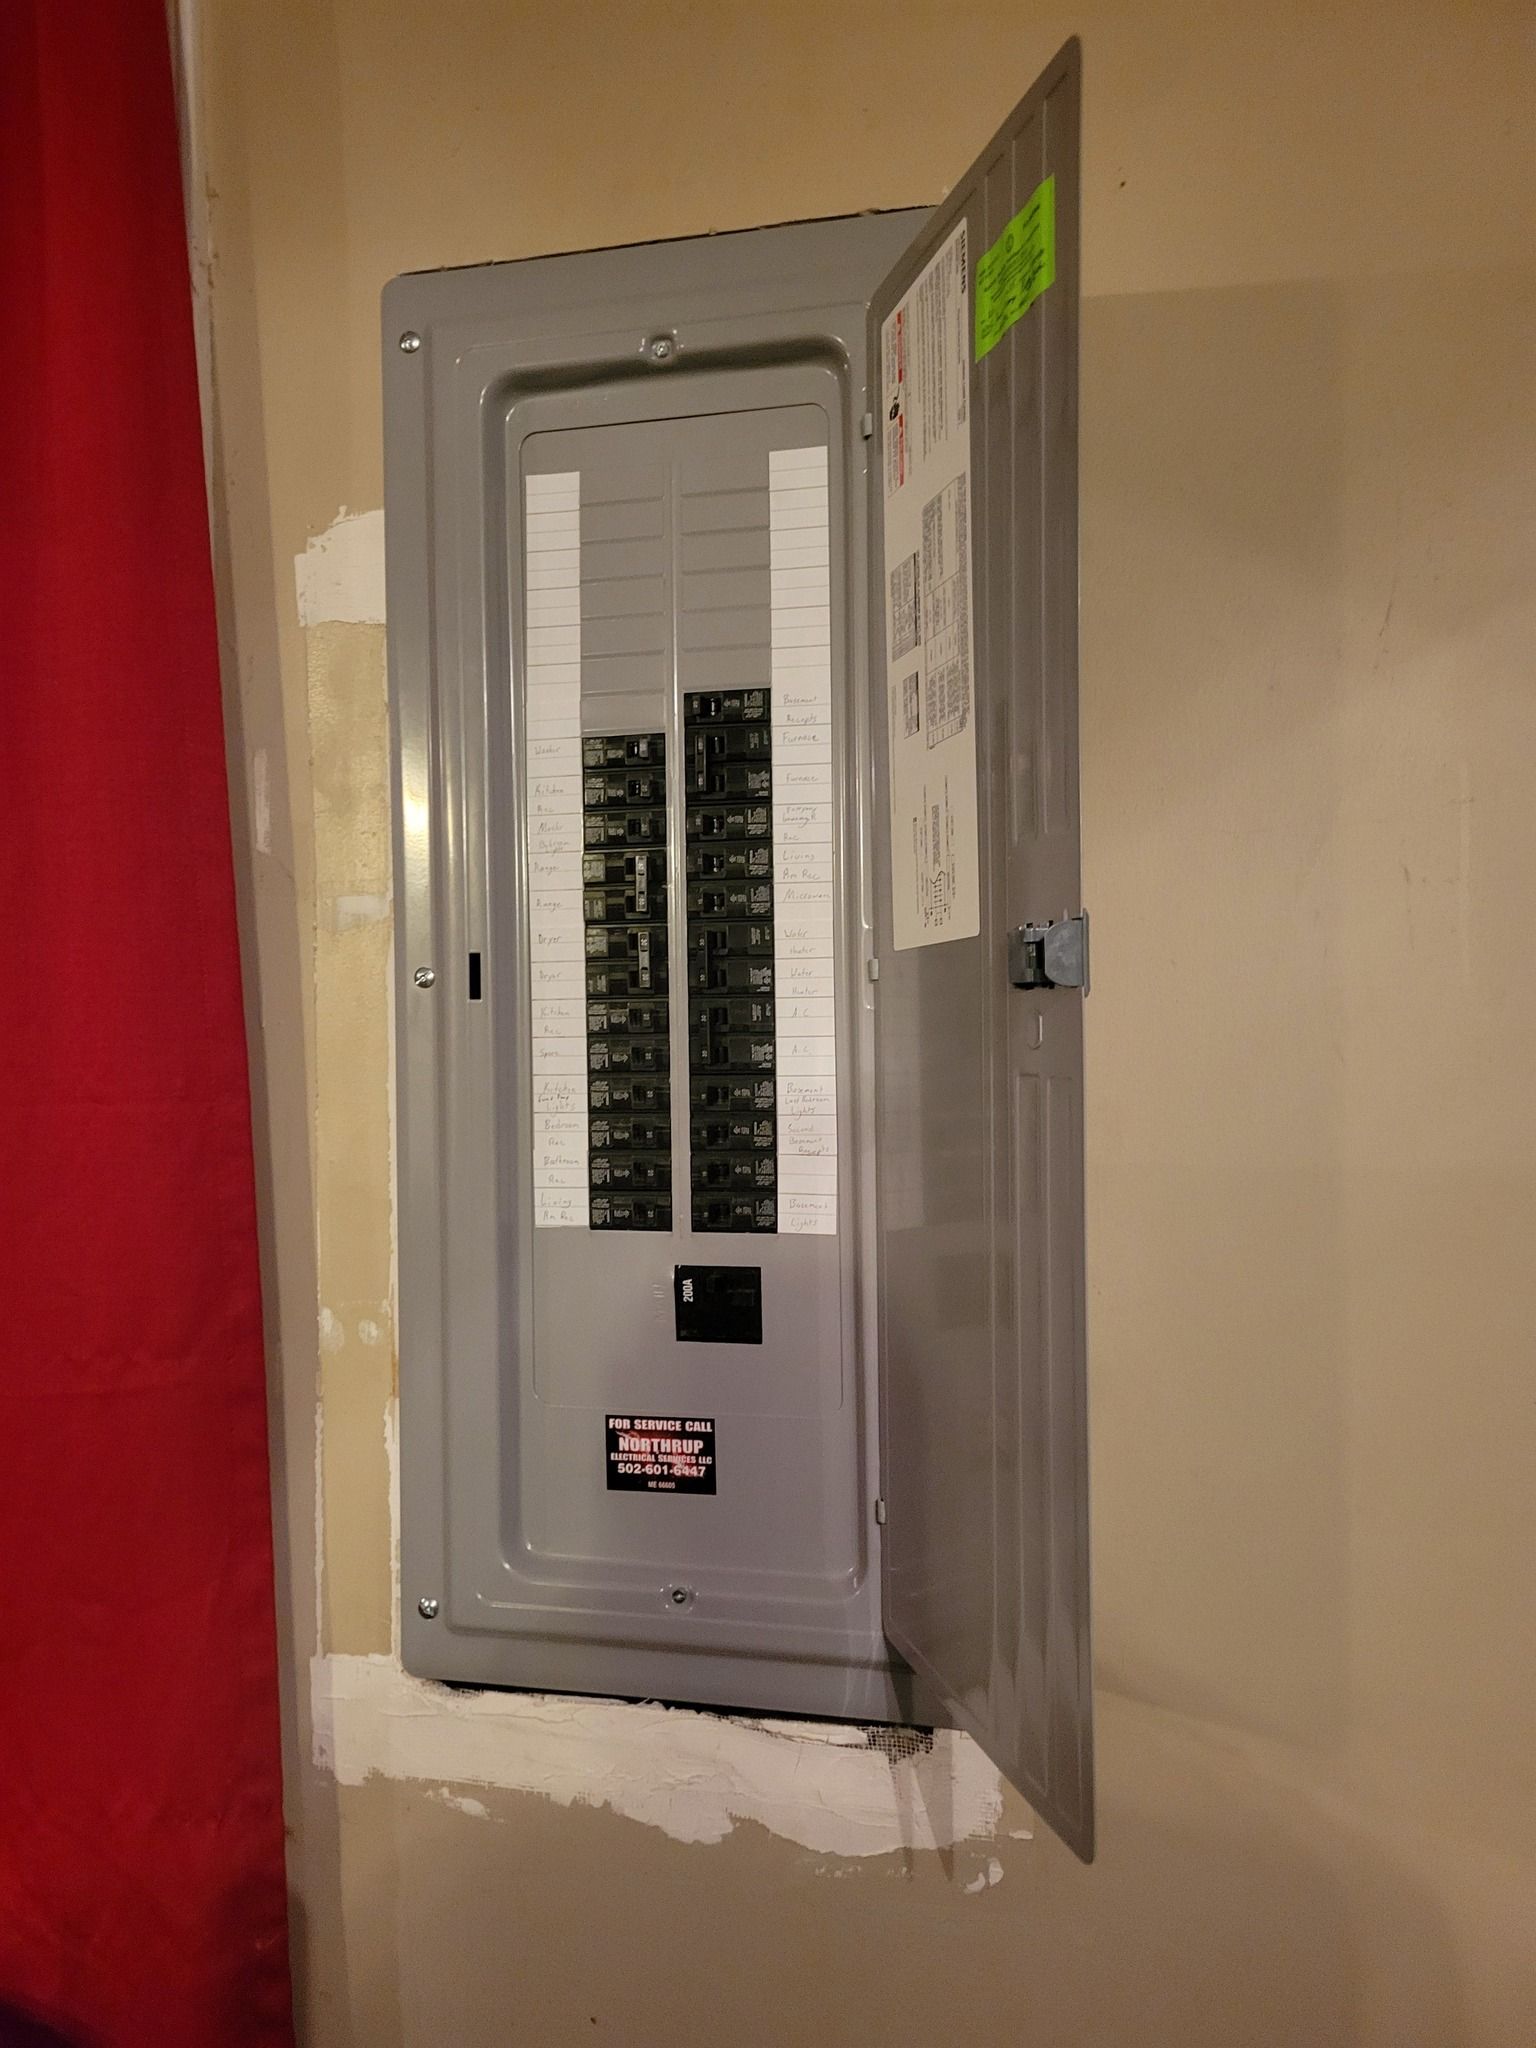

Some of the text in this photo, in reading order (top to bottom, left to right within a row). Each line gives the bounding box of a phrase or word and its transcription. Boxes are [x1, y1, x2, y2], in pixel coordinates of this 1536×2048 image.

[682, 1278, 694, 1303] 200A
[608, 1418, 712, 1432] FOR SERVICE CALL
[618, 1437, 704, 1454] NORTHRUP
[610, 1452, 712, 1464] ELECTRICAL SERVICES LLC
[617, 1463, 706, 1477] 502-601-6447
